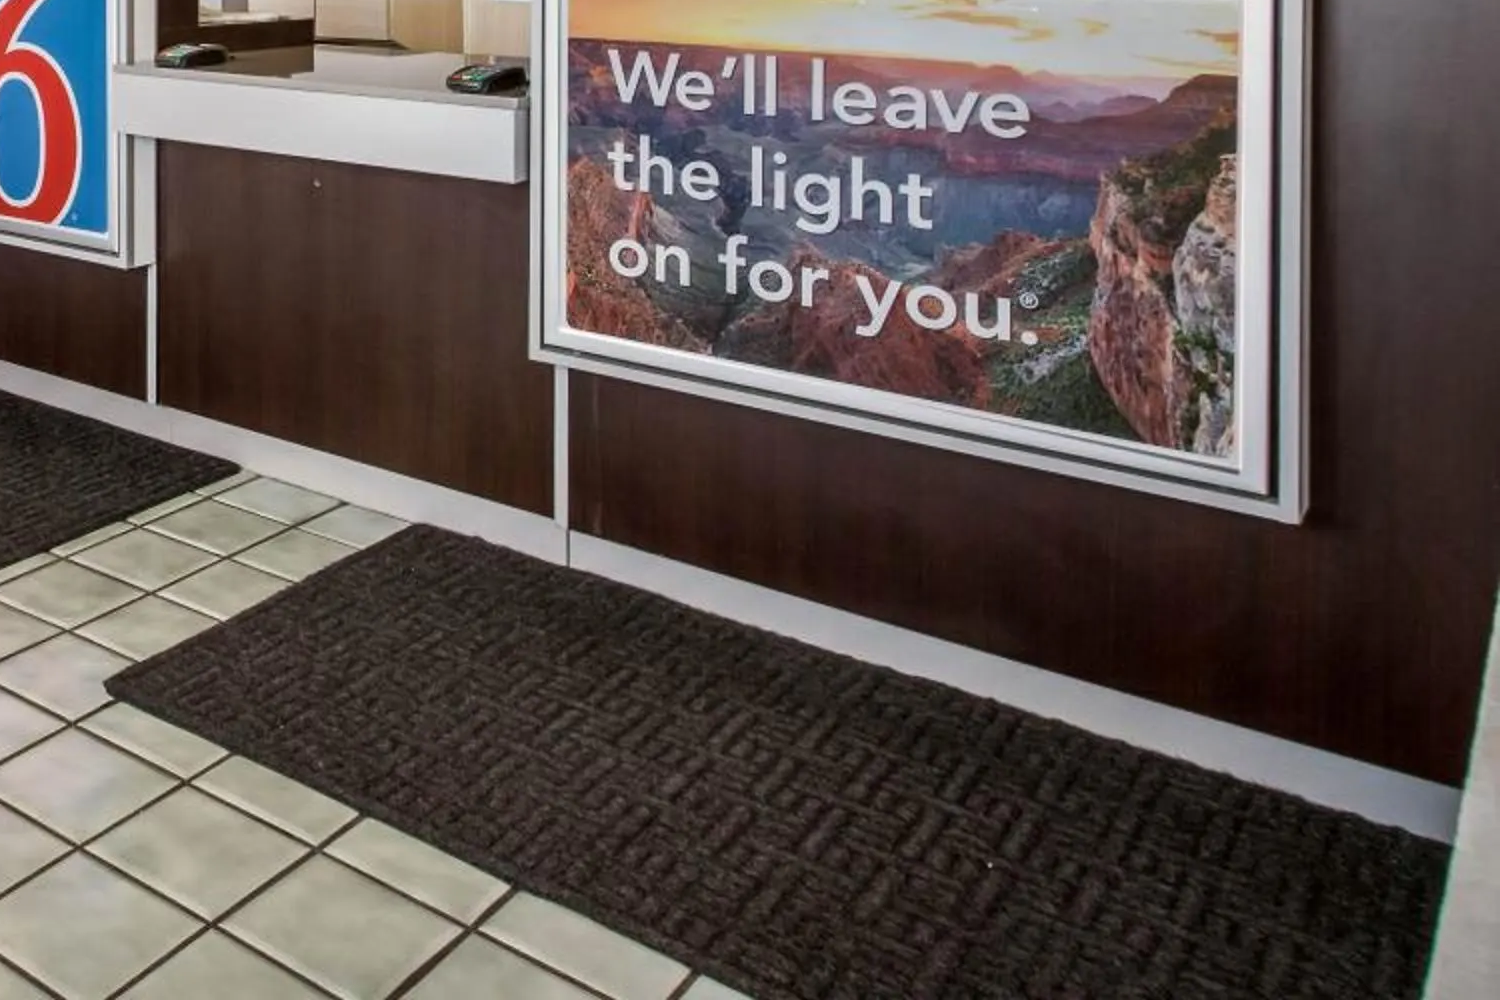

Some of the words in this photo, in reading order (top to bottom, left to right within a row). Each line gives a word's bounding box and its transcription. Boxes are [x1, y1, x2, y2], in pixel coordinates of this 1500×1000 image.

[607, 48, 777, 117] We'll
[810, 57, 1031, 139] leave
[607, 134, 720, 201] the
[750, 145, 934, 235] light
[609, 237, 691, 288] on
[717, 234, 829, 308] for
[854, 274, 1039, 346] you.
